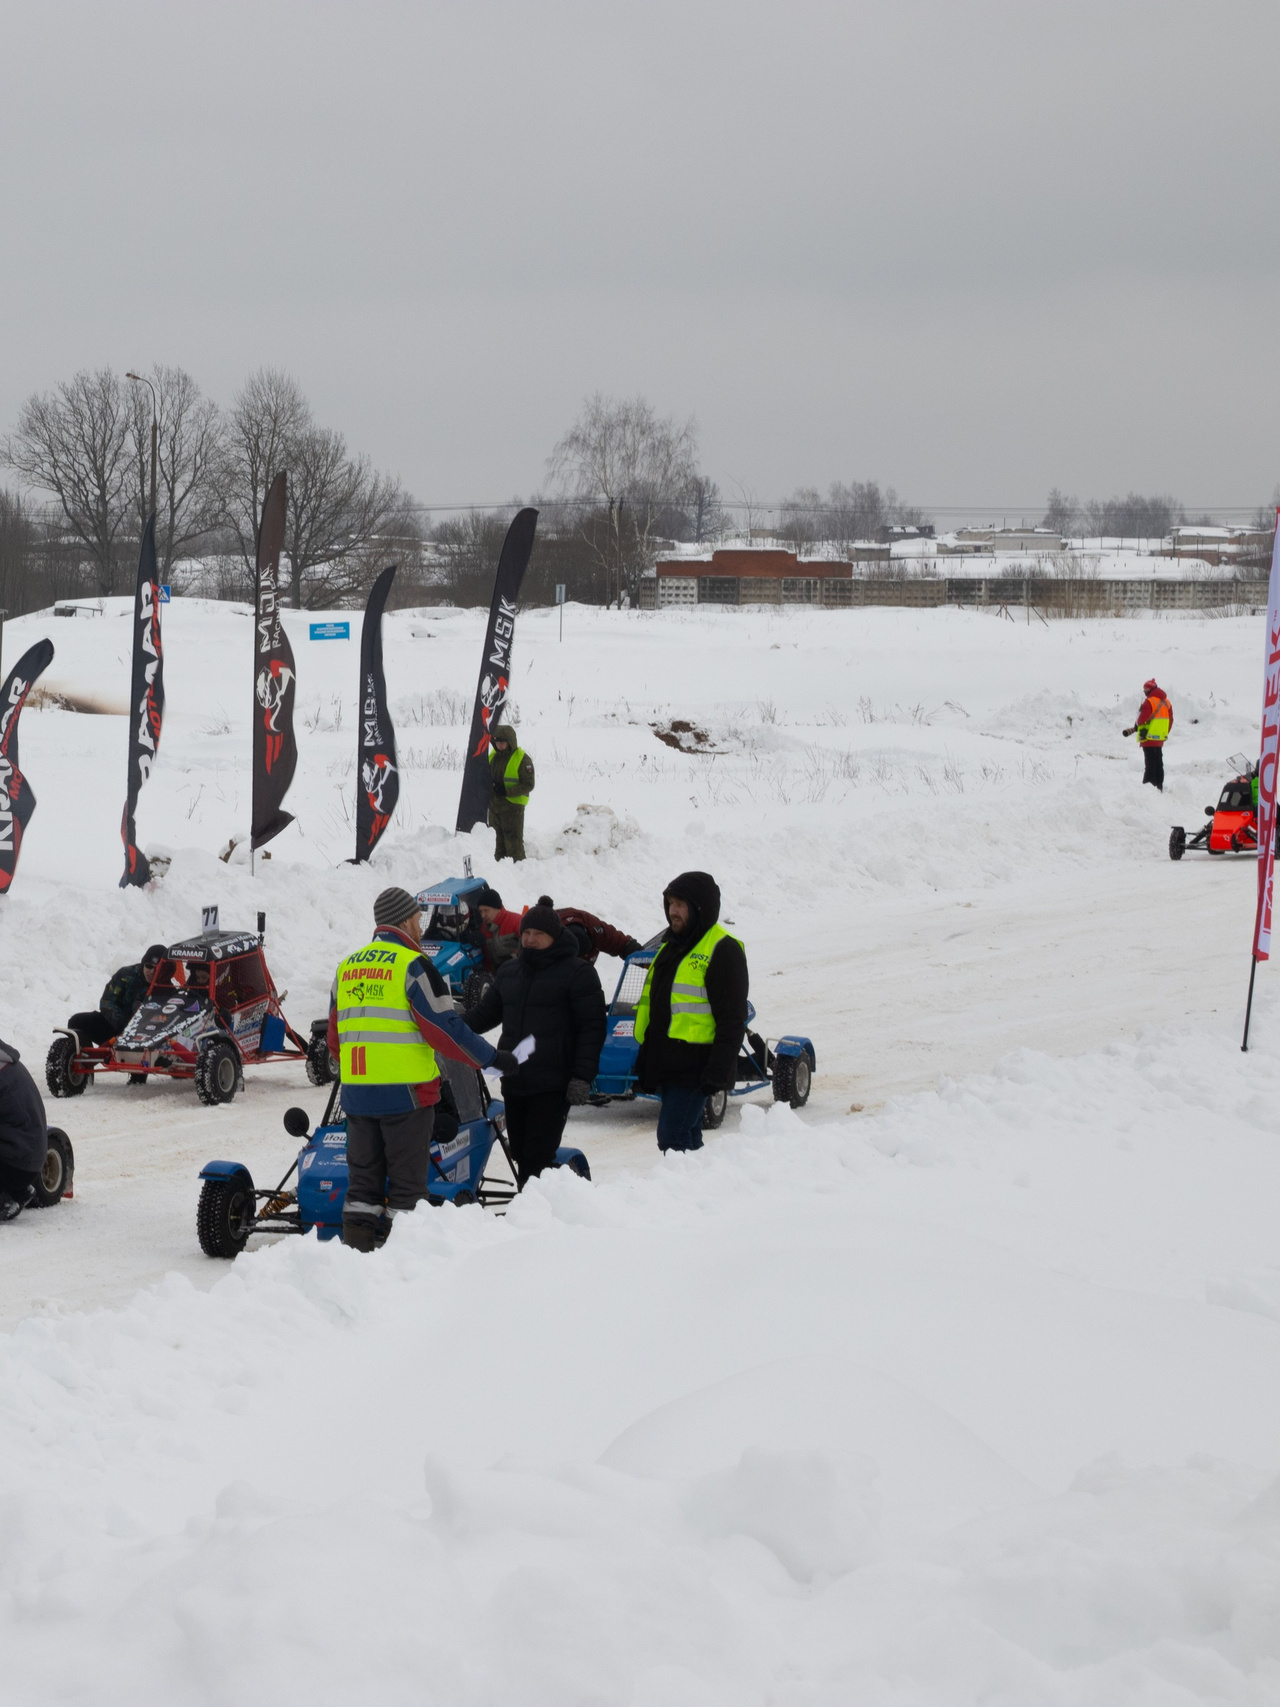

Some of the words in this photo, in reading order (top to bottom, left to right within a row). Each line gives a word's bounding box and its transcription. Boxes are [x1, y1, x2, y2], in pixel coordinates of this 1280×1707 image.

[490, 593, 517, 669] MSK
[202, 906, 218, 927] 77
[171, 949, 204, 958] KRAMAR
[347, 949, 398, 965] RUSTA
[342, 968, 393, 982] МАРШАЛ
[365, 984, 384, 997] MSK
